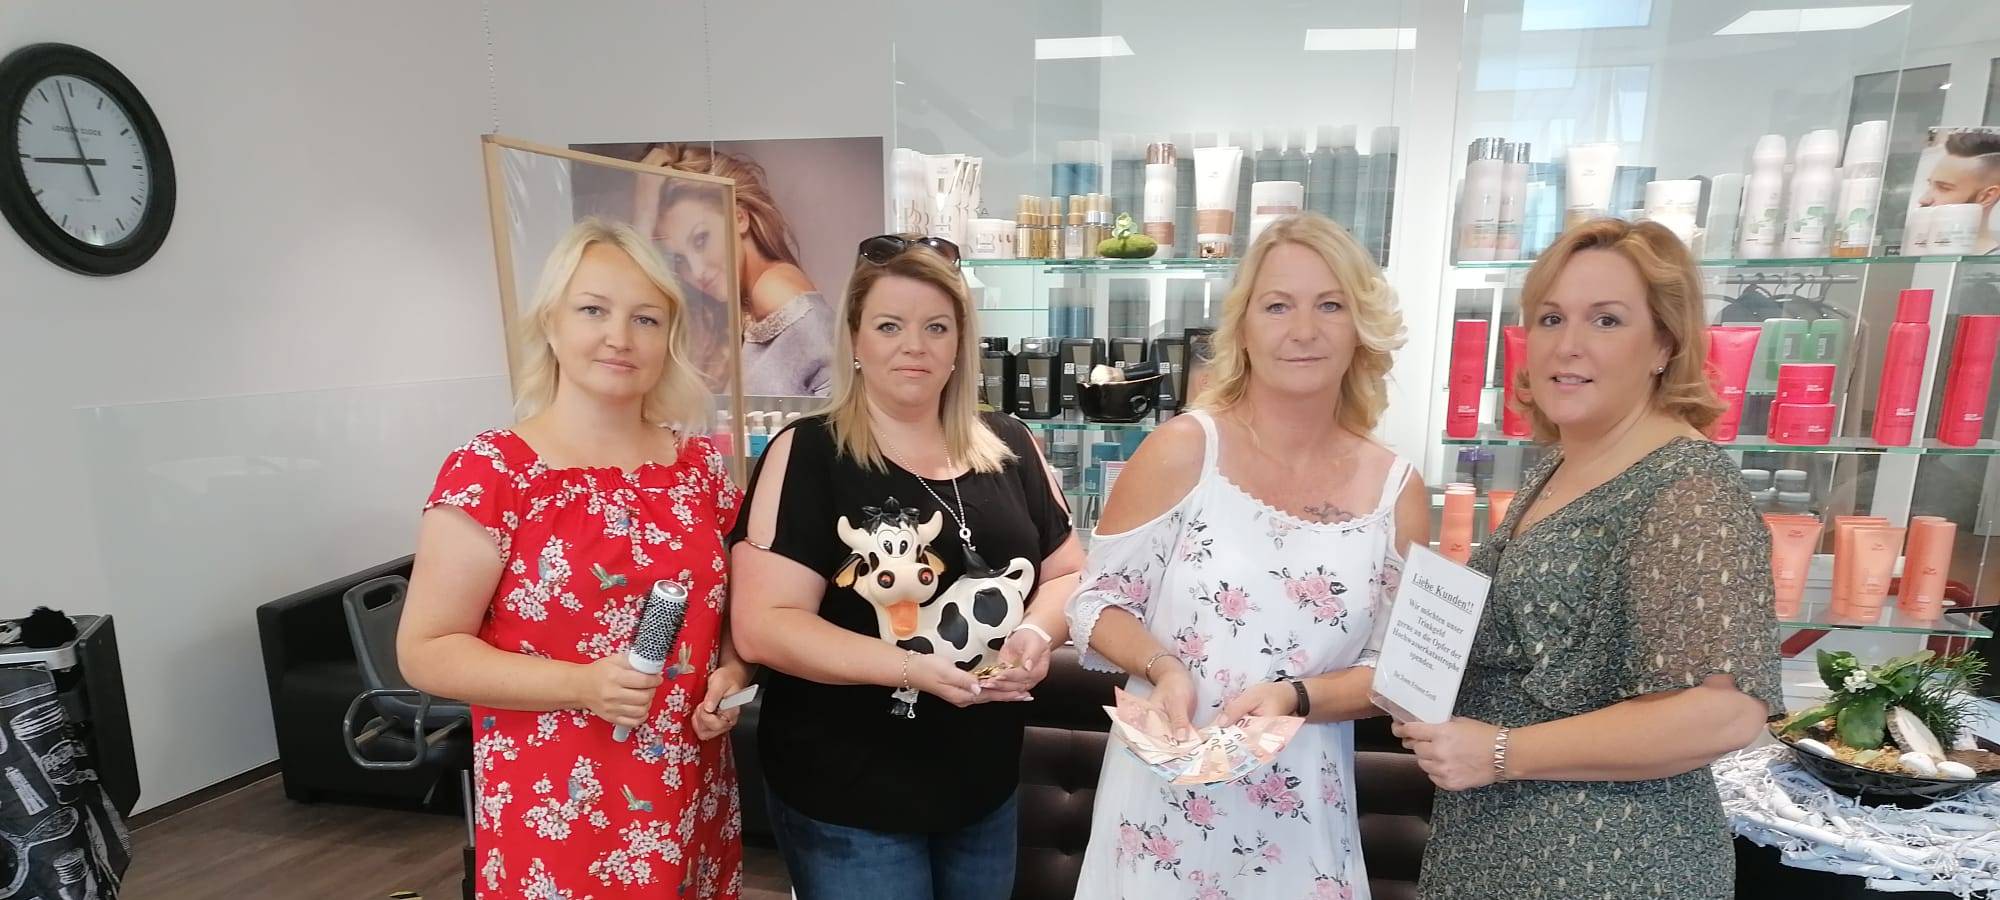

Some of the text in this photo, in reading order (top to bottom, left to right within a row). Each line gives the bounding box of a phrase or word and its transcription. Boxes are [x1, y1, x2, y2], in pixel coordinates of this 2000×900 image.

[1412, 573, 1474, 613] Liebe Kunden!!
[1409, 598, 1464, 635] Wir möchten unser
[1417, 617, 1447, 638] Trinkgeld
[1432, 638, 1452, 654] Opfer
[1450, 649, 1462, 660] der
